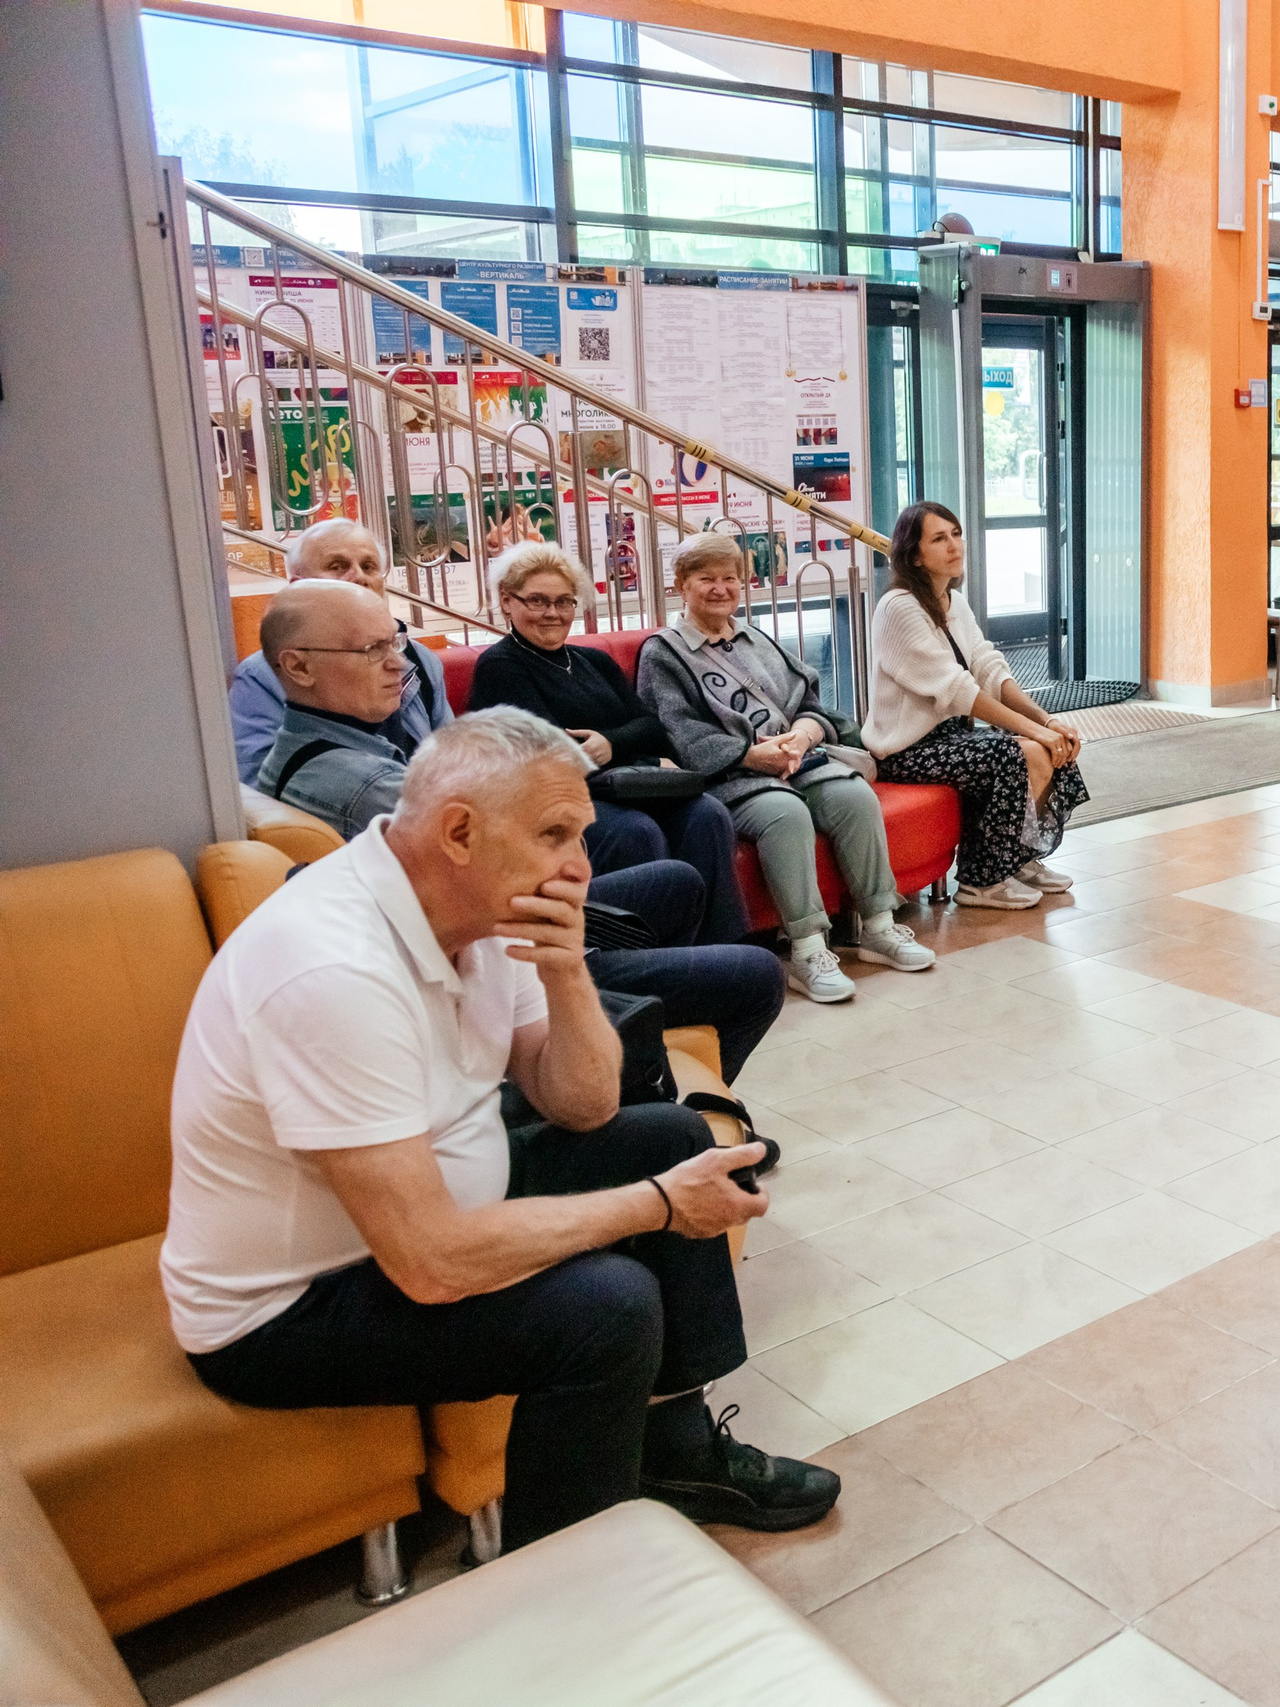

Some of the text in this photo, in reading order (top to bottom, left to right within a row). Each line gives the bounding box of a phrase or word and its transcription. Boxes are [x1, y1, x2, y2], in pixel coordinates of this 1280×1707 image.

[477, 262, 517, 270] КУЛЬТУРНОГО
[719, 275, 760, 285] РАСПИСАНИЕ
[982, 369, 1013, 386] ЫХОД
[561, 409, 612, 418] МНОГОЛИК
